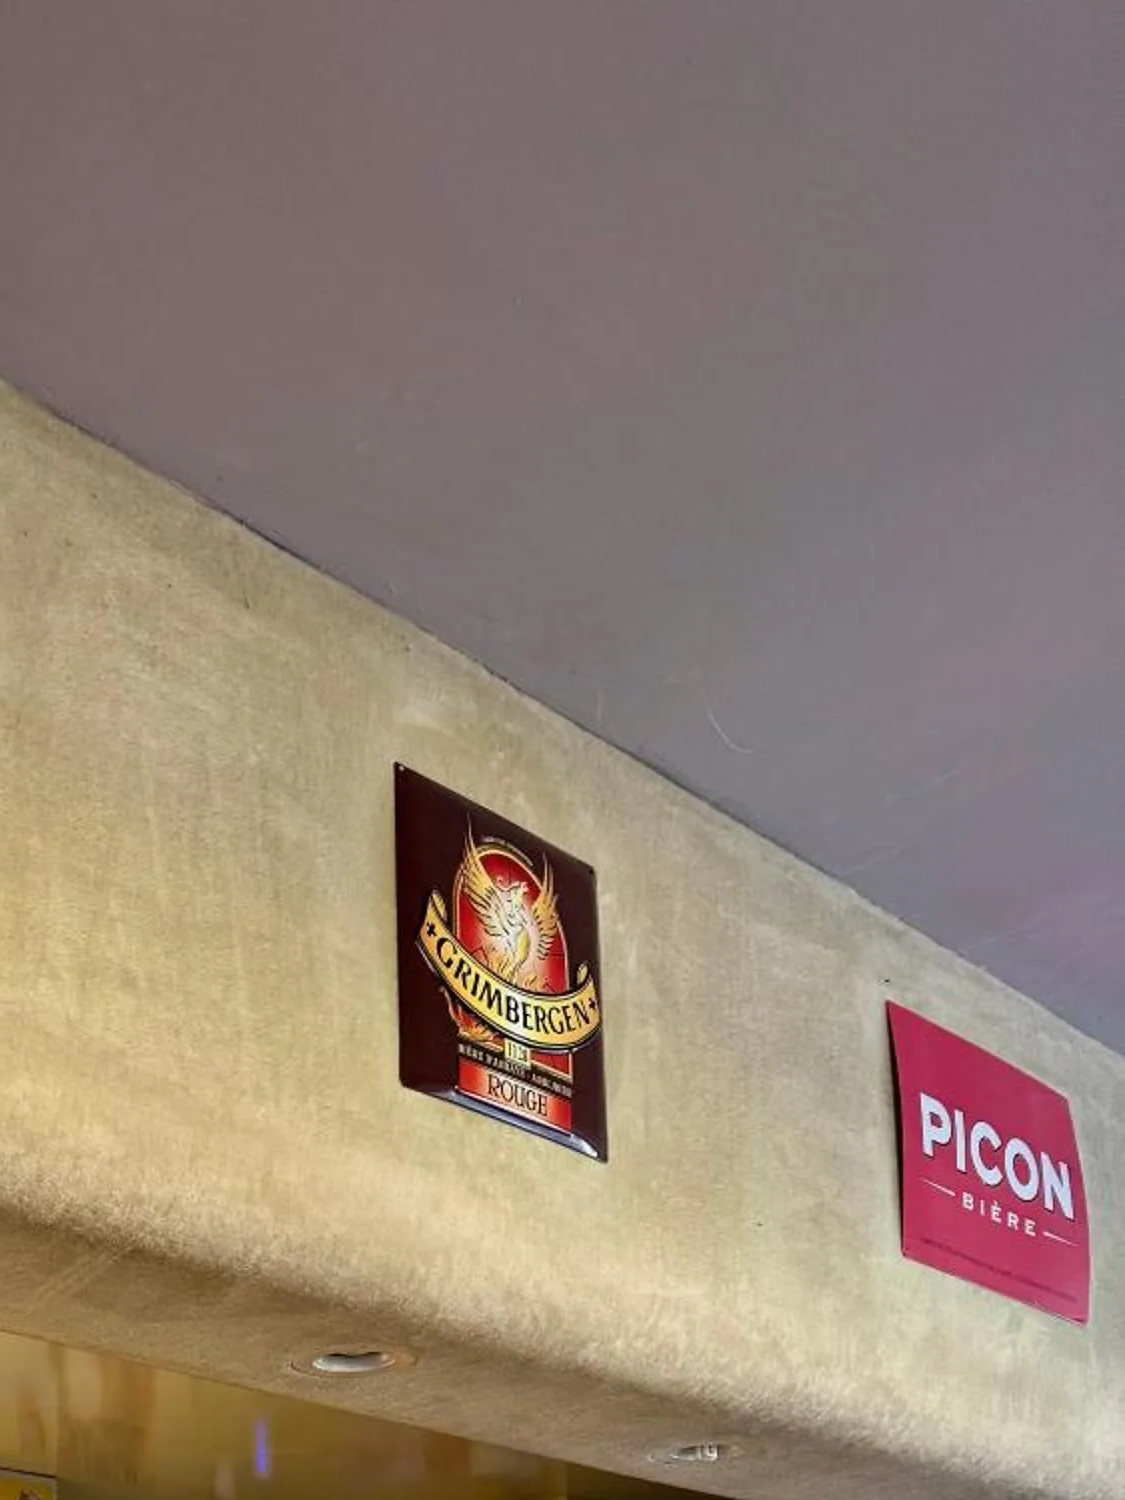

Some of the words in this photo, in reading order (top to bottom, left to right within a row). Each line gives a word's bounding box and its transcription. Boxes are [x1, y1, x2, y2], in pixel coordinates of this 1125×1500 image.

[435, 934, 591, 1036] GRIMBERGEN
[487, 1073, 548, 1117] ROUGE
[919, 1092, 1075, 1221] PICON
[961, 1192, 1037, 1237] BIÈRE
